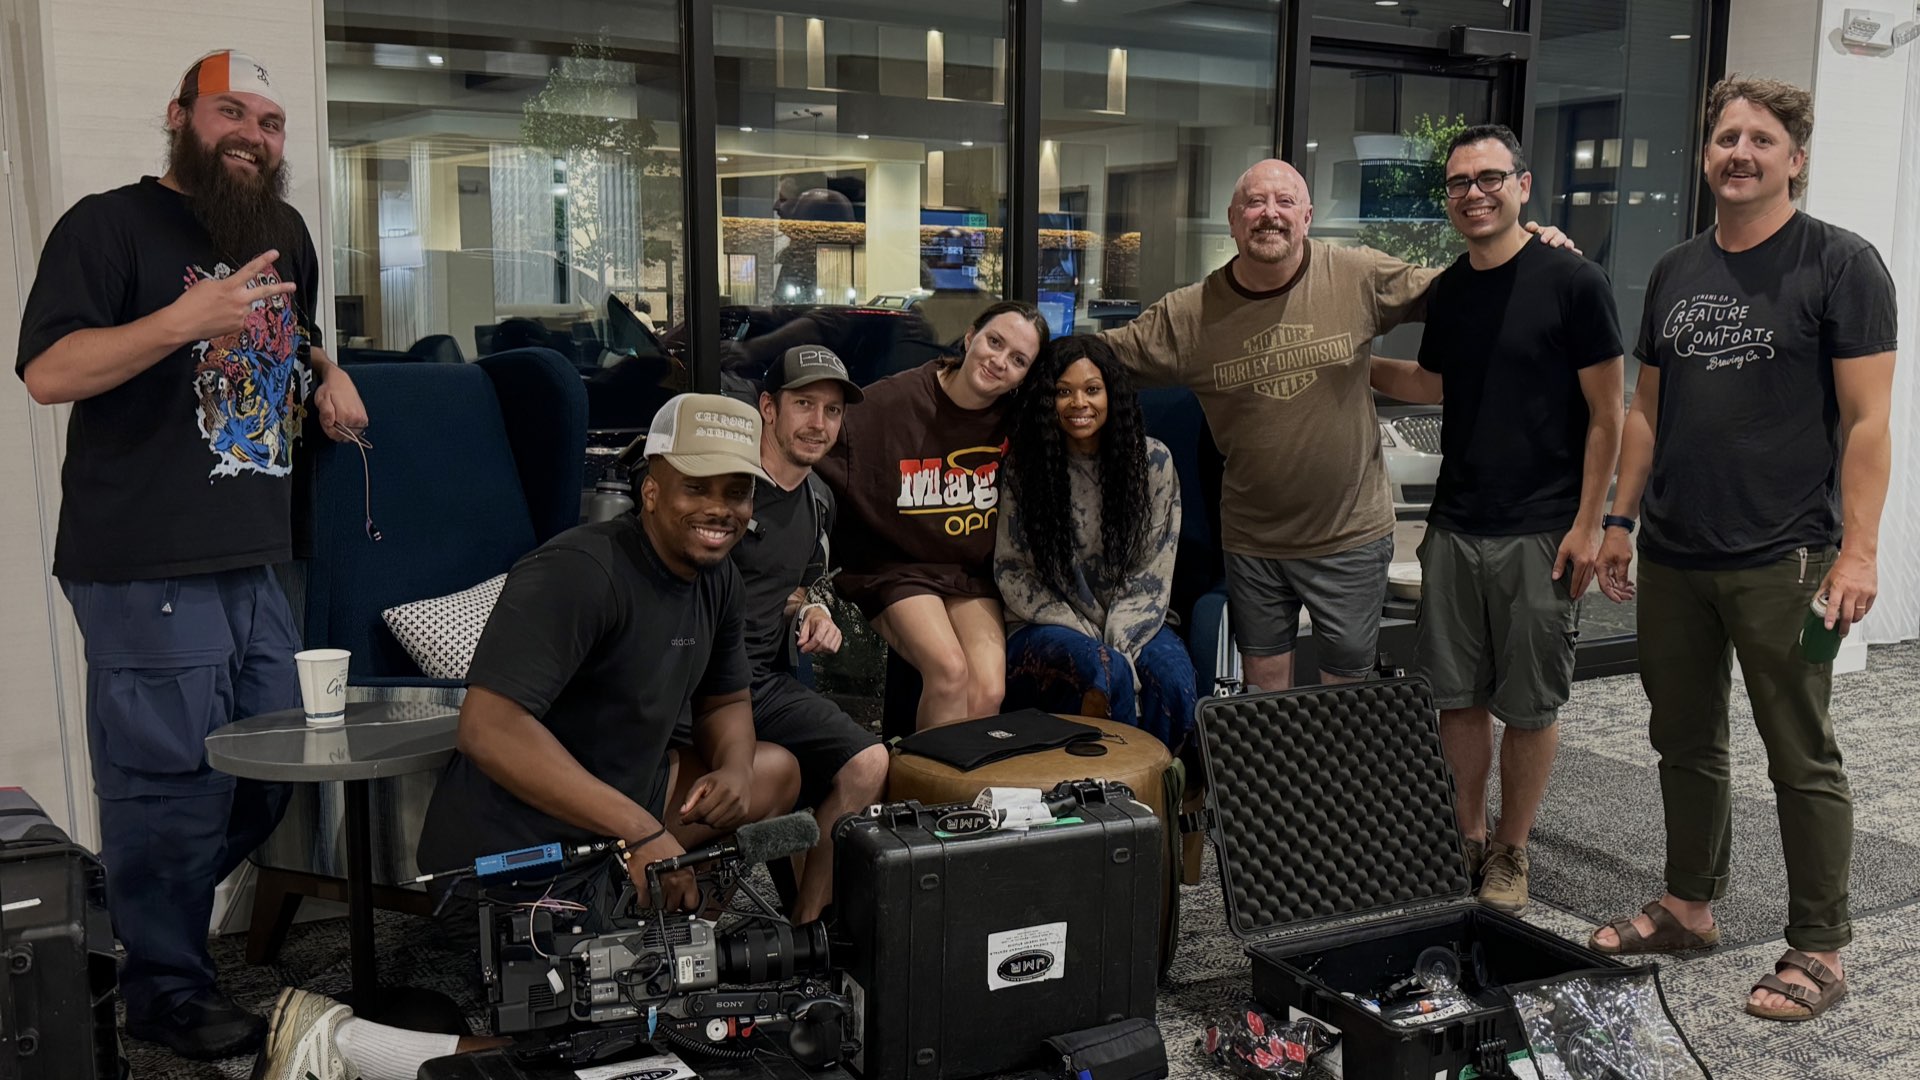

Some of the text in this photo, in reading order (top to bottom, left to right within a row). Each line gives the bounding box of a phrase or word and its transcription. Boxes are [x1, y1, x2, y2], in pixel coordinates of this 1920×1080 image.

[1663, 298, 1750, 338] CREATURE
[1250, 326, 1307, 352] MOTOR
[1674, 321, 1775, 357] COMFORTS
[1218, 338, 1350, 386] HARLEY-DAVIDSON
[1706, 349, 1760, 370] Brewing Co.
[1255, 372, 1313, 397] CYCLES
[946, 816, 984, 830] JMR
[1009, 957, 1046, 974] JMR
[716, 1000, 745, 1008] SONY
